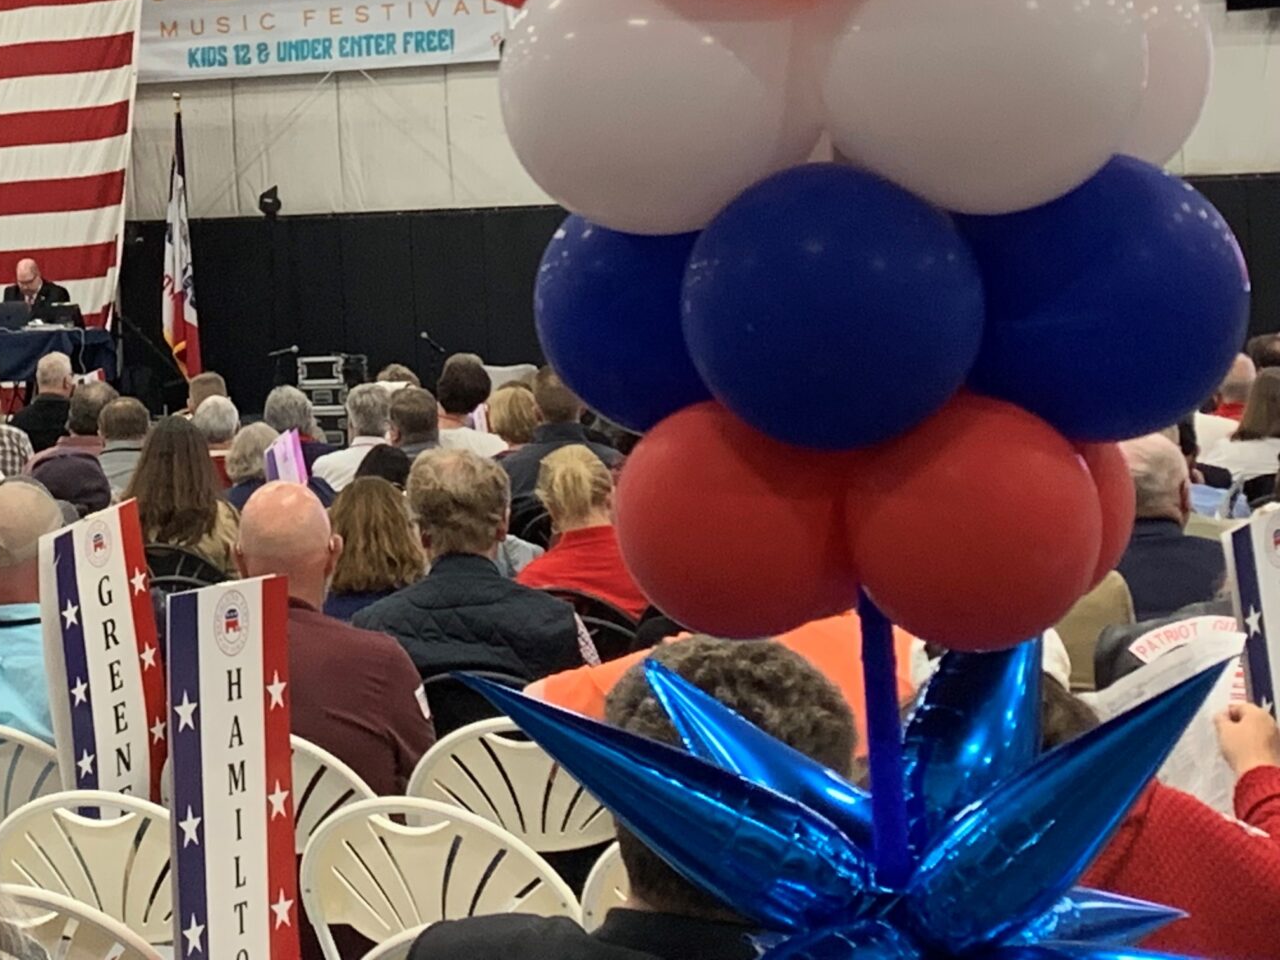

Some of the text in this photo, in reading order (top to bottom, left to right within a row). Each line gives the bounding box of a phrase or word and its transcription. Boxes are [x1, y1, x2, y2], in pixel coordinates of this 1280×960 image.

[160, 13, 276, 38] MUSIC
[187, 28, 455, 68] KIDS 12 & UNDER ENTER FREE!
[1135, 622, 1198, 658] PATRIOT
